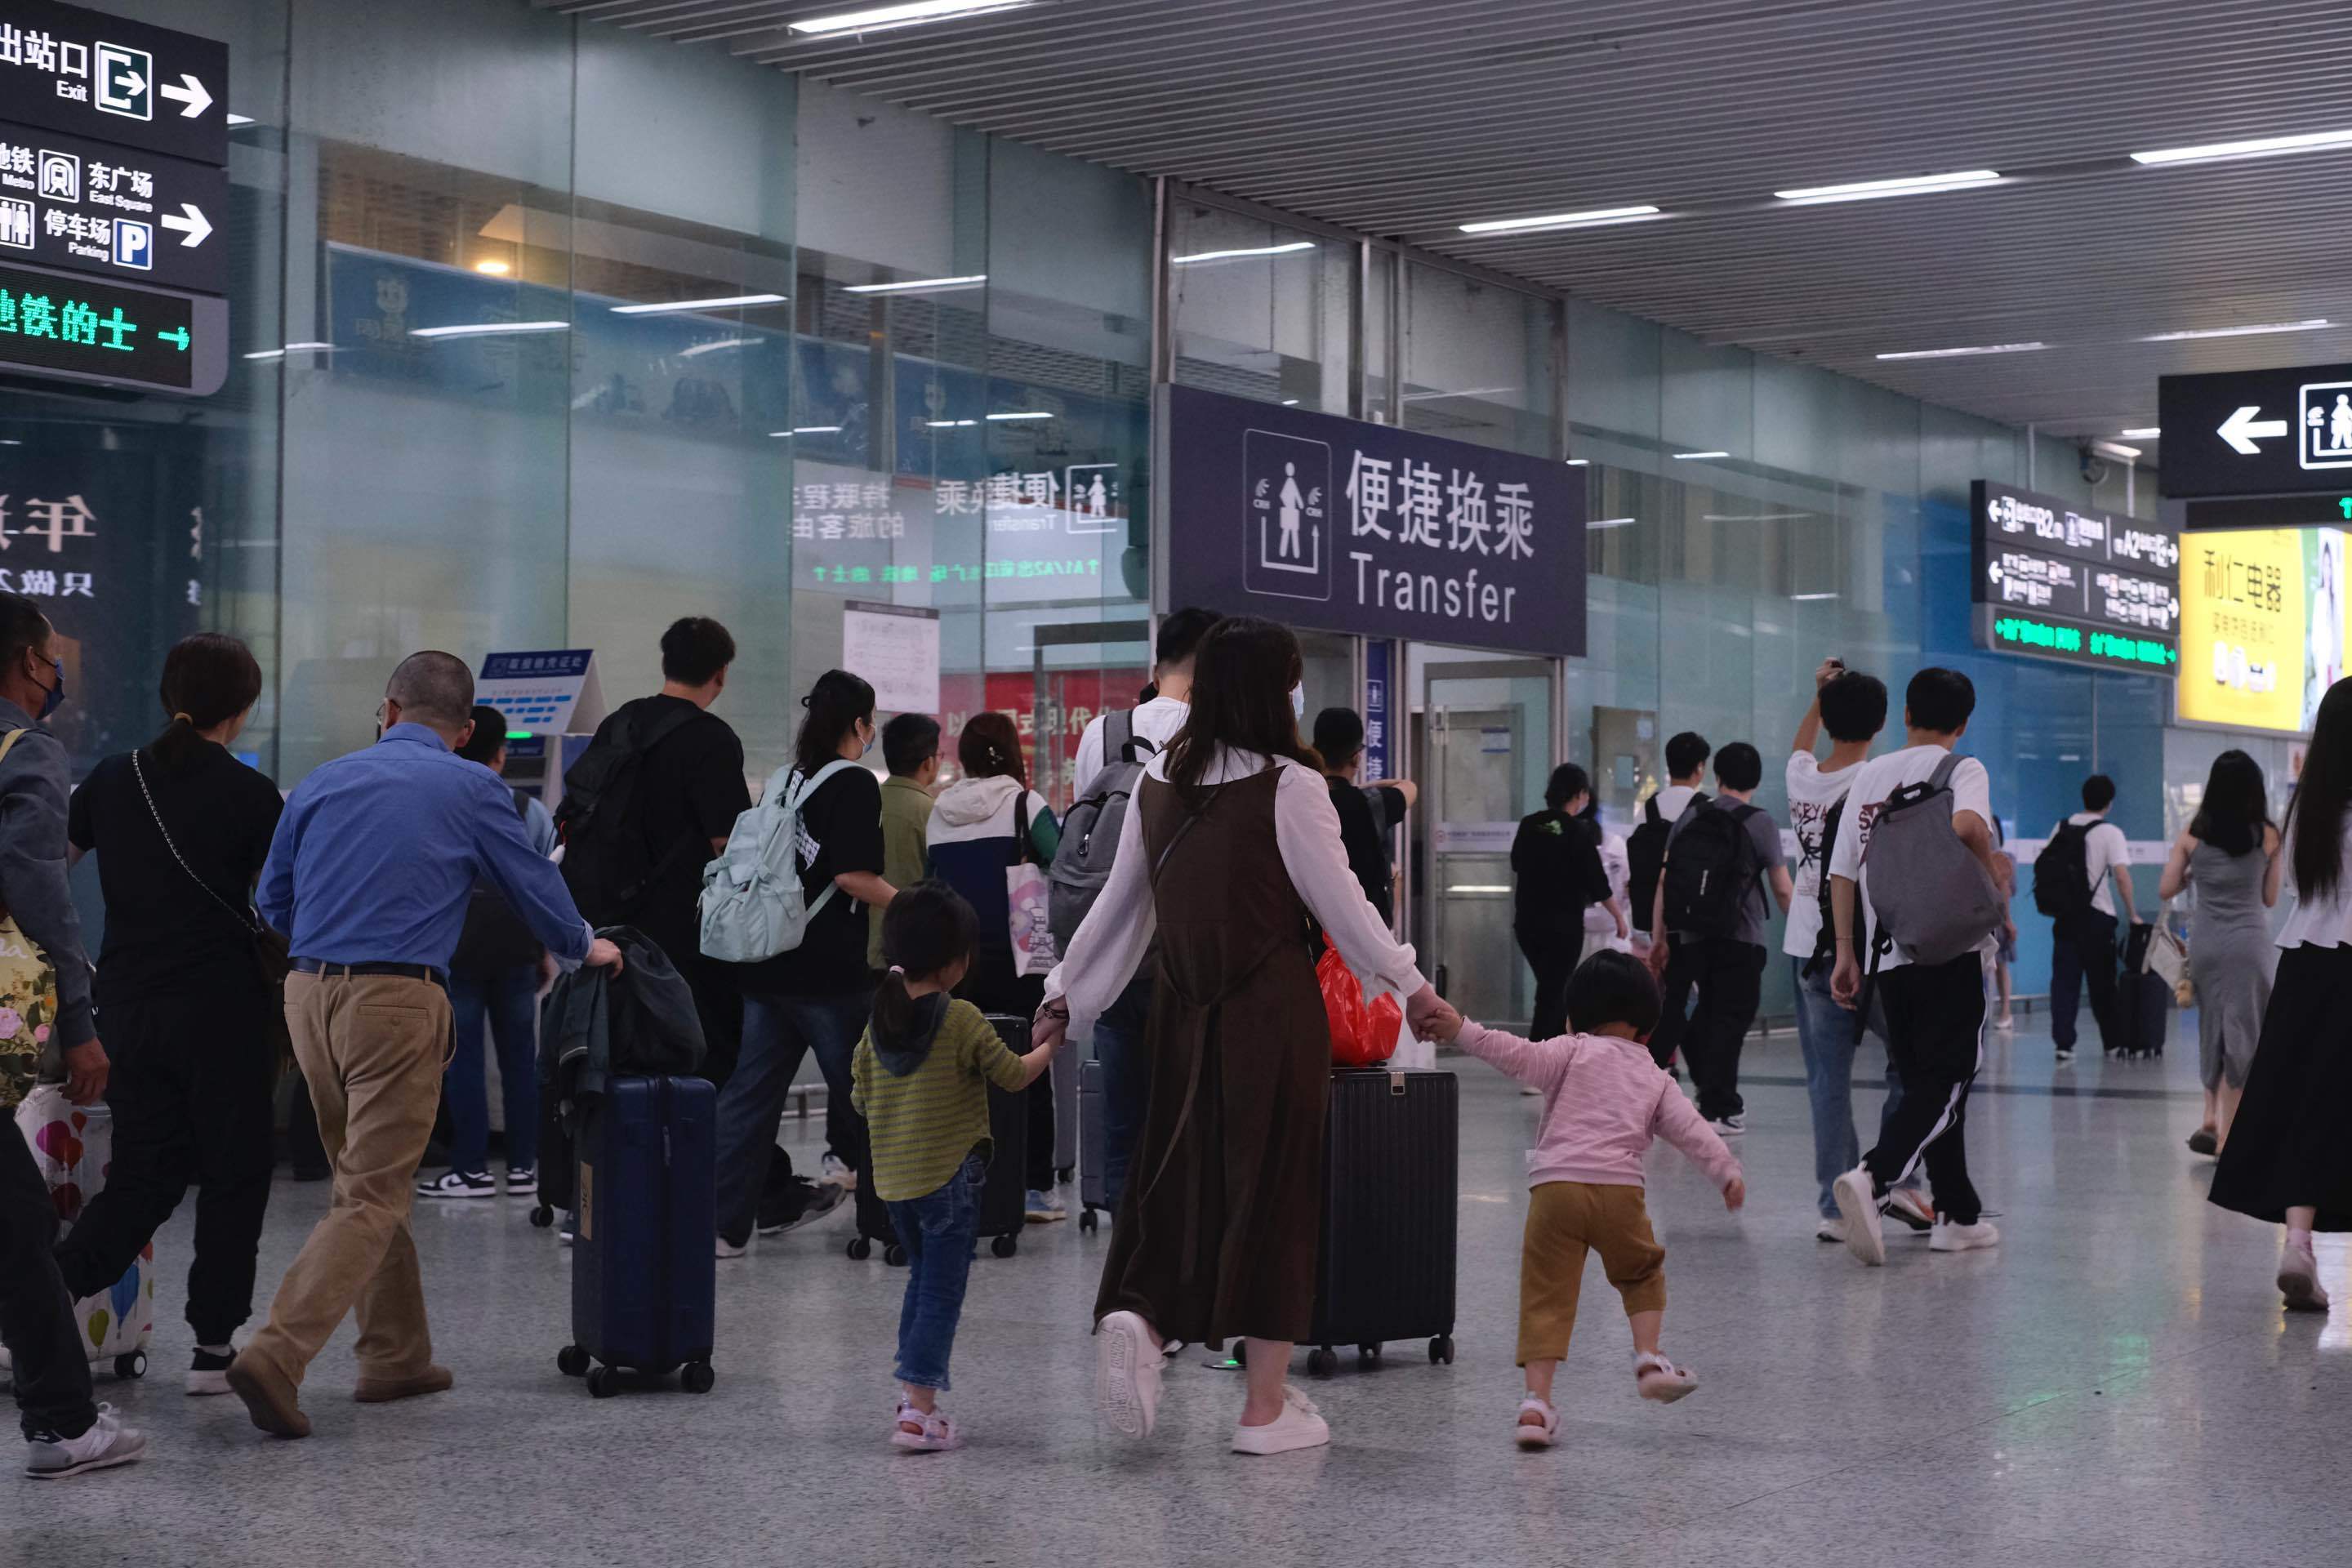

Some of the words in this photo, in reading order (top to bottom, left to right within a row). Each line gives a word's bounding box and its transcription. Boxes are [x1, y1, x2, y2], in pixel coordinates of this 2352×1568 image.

[0, 24, 87, 78] 出站口
[56, 80, 87, 102] Exit
[2, 173, 35, 190] Metro
[87, 162, 154, 198] 东广场
[89, 190, 114, 206] East
[115, 195, 154, 212] Square
[43, 208, 111, 245] 停车场
[68, 242, 110, 262] Parking
[1345, 449, 1535, 561] 便捷换乘
[1349, 551, 1516, 623] Transfer
